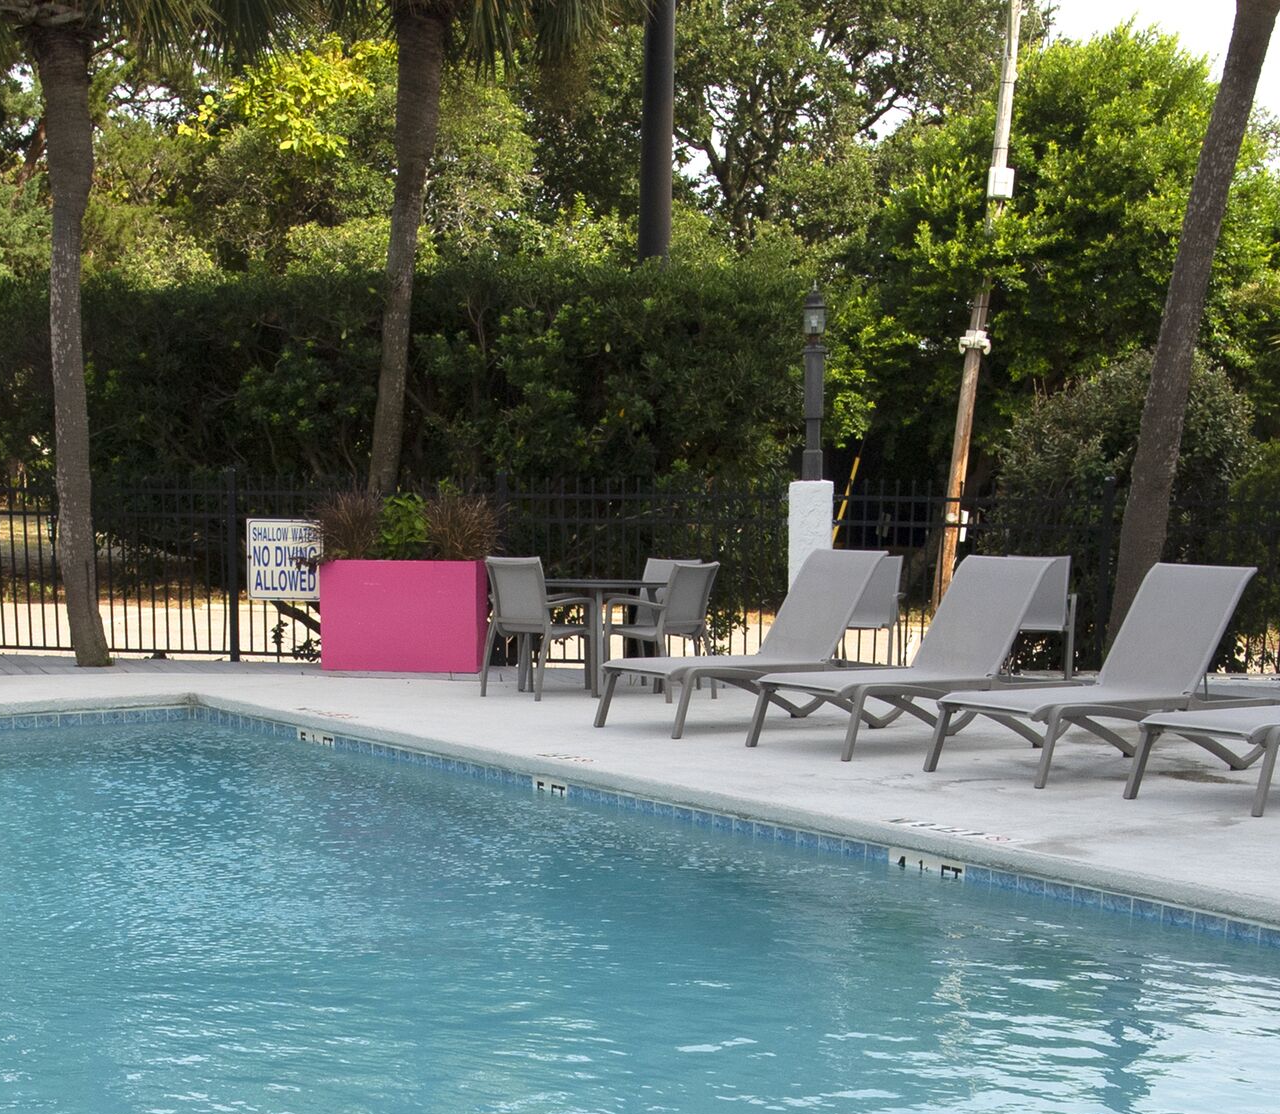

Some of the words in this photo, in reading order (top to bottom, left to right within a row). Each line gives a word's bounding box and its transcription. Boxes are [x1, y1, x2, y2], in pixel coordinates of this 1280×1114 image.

[252, 527, 289, 542] SHALLOW
[253, 546, 271, 567] NO
[255, 570, 316, 591] ALLOWED
